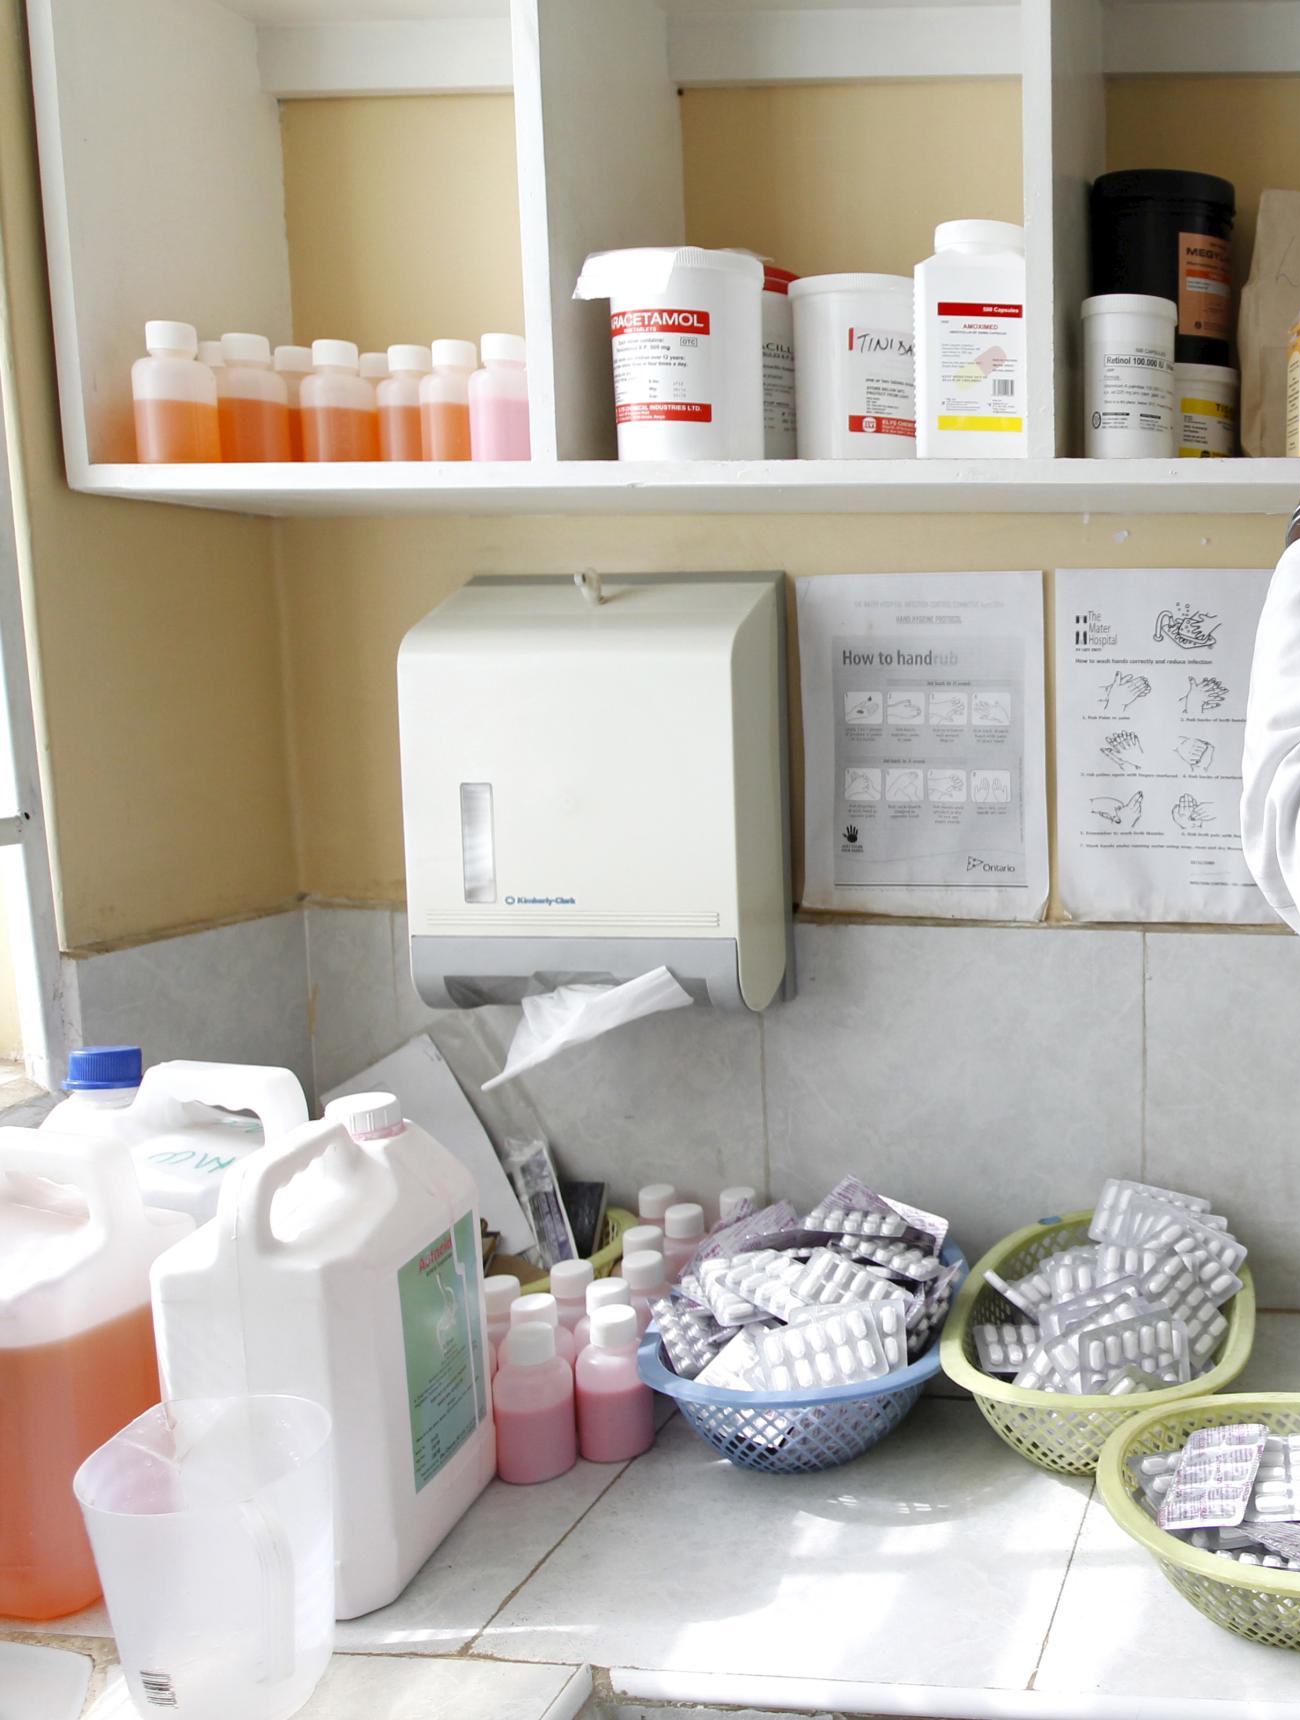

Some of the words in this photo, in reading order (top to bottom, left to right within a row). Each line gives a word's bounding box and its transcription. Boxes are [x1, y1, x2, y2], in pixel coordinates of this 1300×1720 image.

[612, 312, 704, 329] RACETAMOL
[1106, 356, 1131, 365] Retinol
[1133, 357, 1158, 368] 100.000
[1088, 610, 1102, 622] The
[1088, 622, 1111, 634] Mater
[1088, 634, 1118, 648] Hospital
[842, 649, 874, 665] How
[879, 650, 894, 666] to
[896, 648, 959, 666] handrub
[982, 863, 1016, 873] Ontario
[517, 896, 576, 906] Kimberly-Clark
